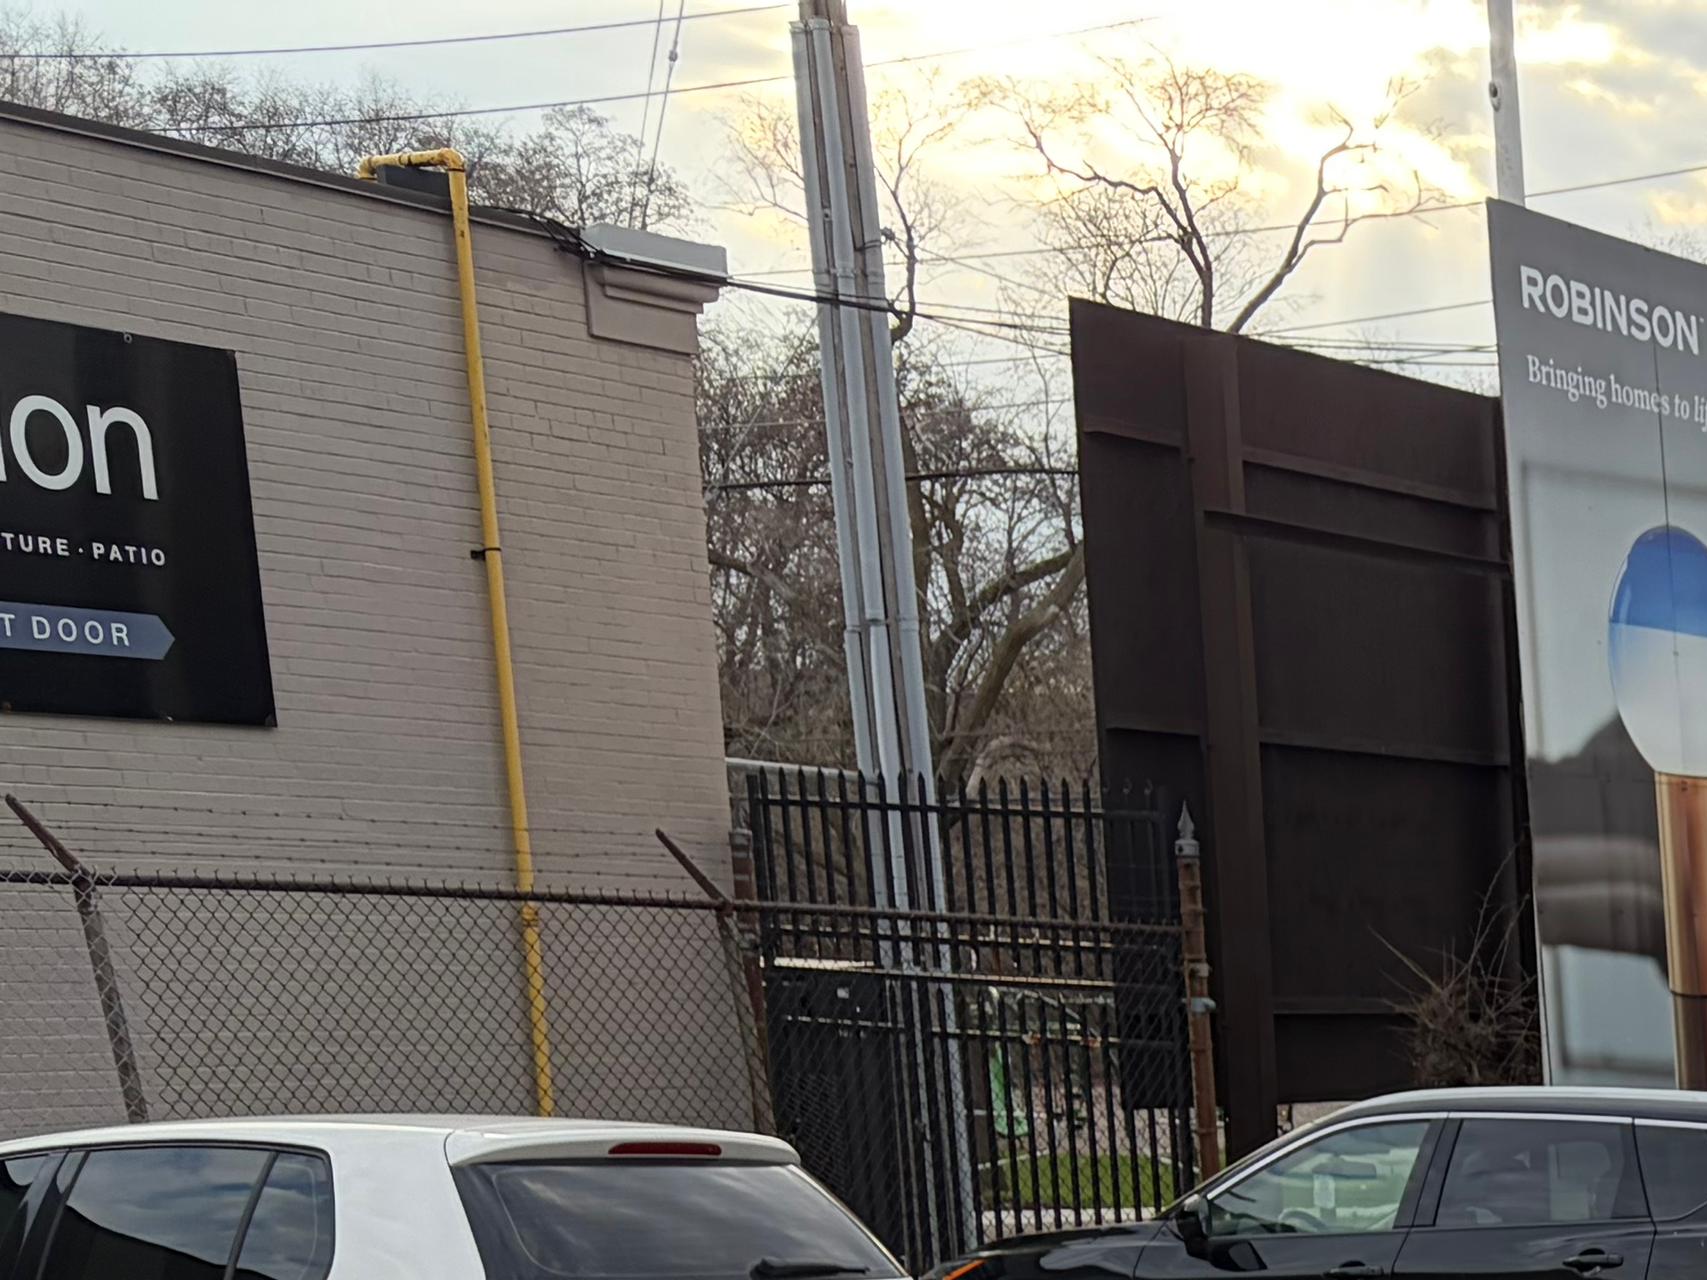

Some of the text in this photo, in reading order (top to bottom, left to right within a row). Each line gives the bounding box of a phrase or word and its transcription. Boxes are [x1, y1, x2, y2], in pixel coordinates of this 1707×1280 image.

[1519, 264, 1699, 356] ROBINSON
[1526, 354, 1608, 409] Bringing
[1609, 373, 1670, 416] homes
[1673, 393, 1690, 420] to
[0, 394, 159, 500] on
[92, 542, 167, 567] PATIO
[31, 615, 130, 647] DOOR
